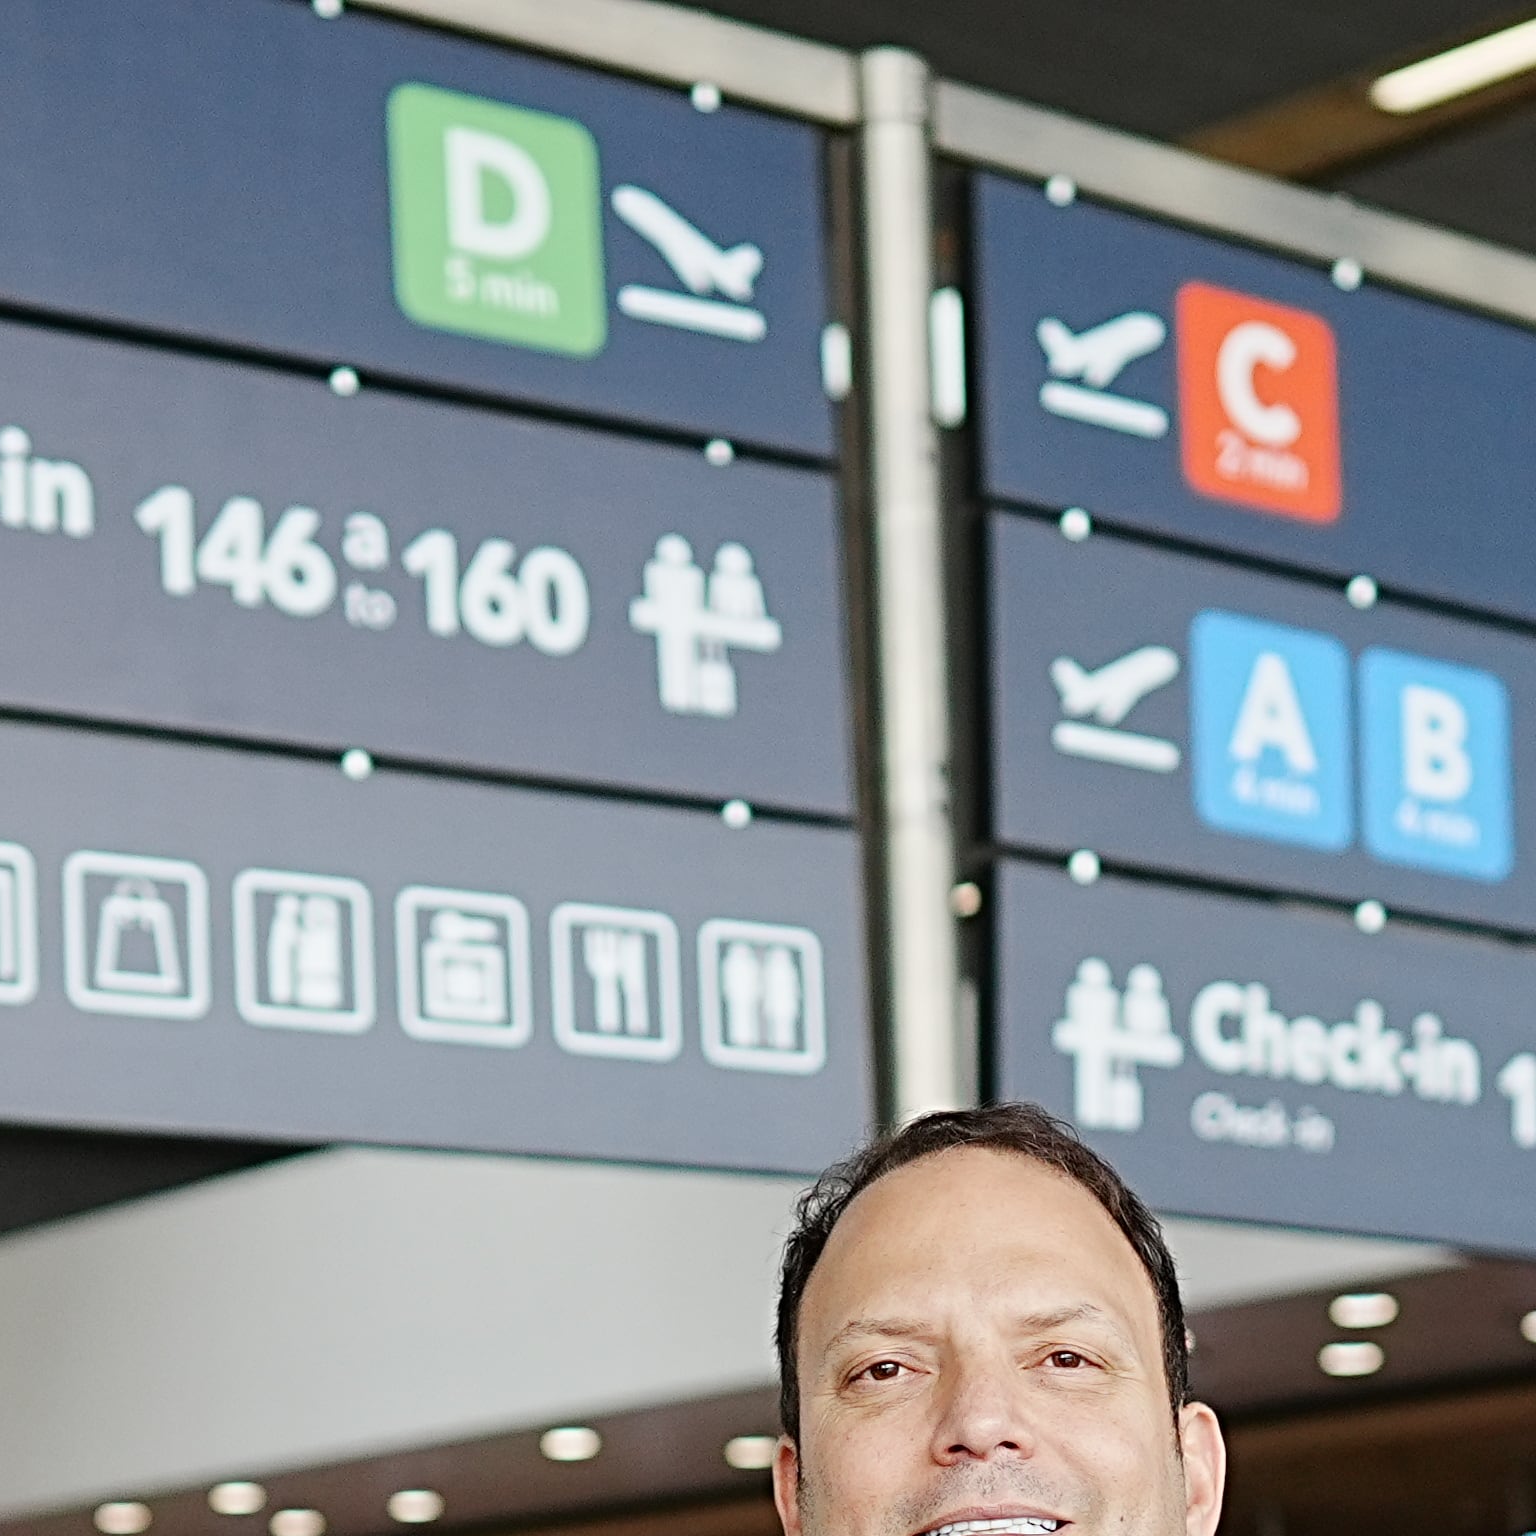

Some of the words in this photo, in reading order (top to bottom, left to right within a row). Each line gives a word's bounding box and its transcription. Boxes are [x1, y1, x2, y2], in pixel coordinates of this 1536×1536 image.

[444, 125, 551, 261] D
[478, 268, 560, 318] min
[1216, 320, 1302, 446] C
[134, 484, 336, 617] 146
[402, 528, 590, 657] 160
[1228, 652, 1317, 773] A
[1401, 684, 1472, 800] B
[1191, 980, 1481, 1106] Check-in
